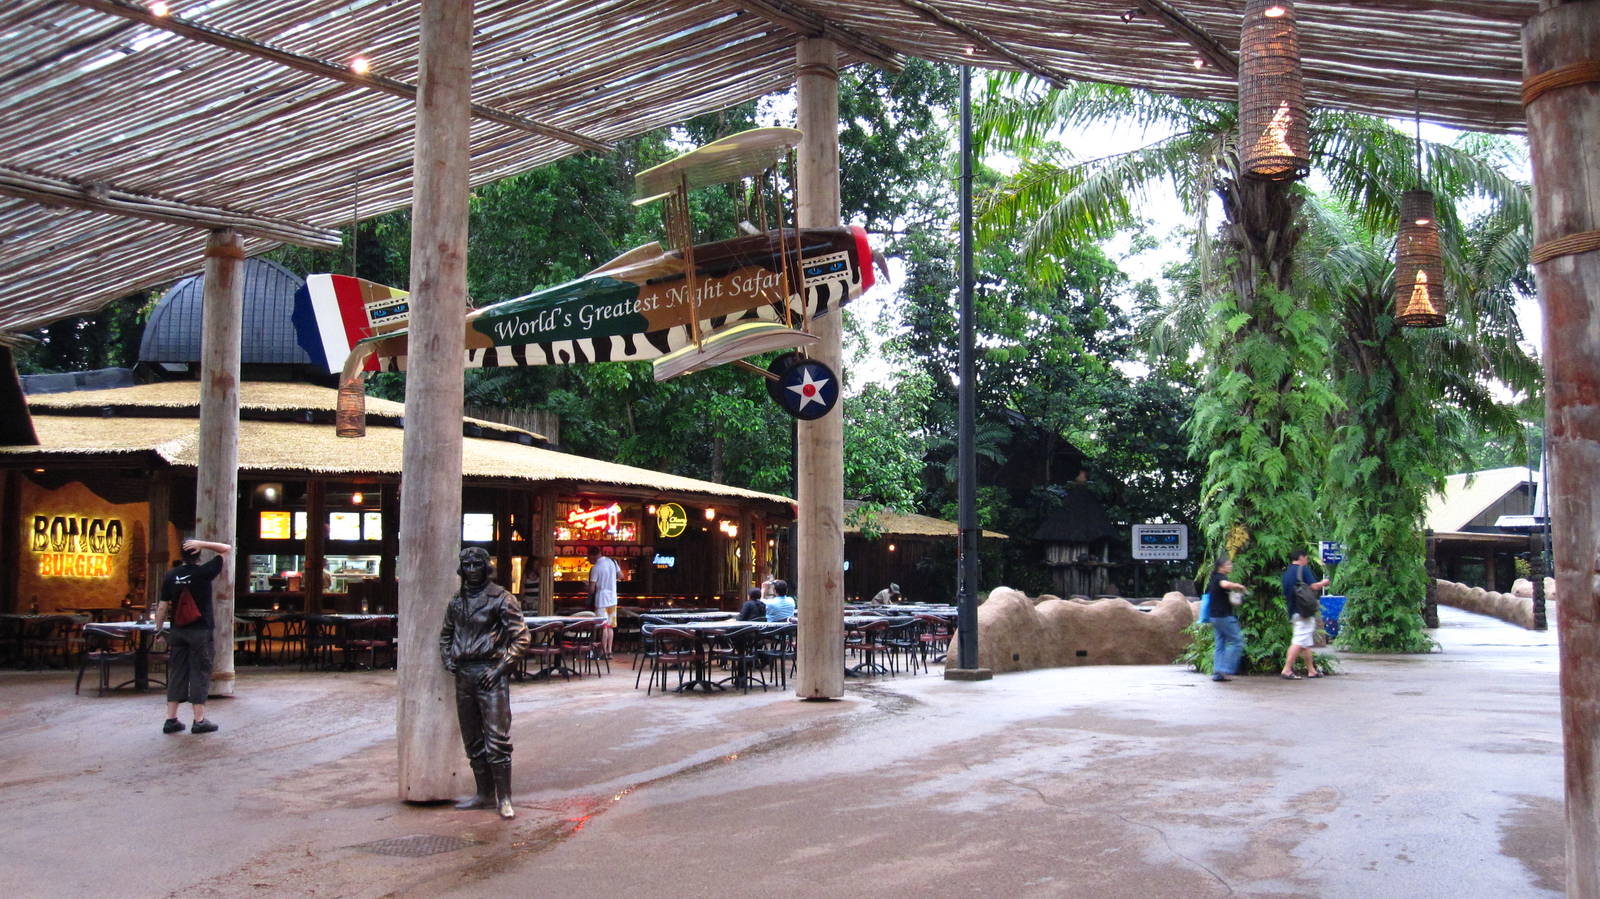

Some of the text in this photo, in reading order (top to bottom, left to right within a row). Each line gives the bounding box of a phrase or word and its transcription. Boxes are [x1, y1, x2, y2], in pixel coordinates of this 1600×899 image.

[494, 307, 572, 340] World's
[579, 296, 660, 329] Greatest
[729, 268, 785, 298] Safar
[33, 514, 123, 554] BONGO
[40, 553, 114, 577] BURGERS
